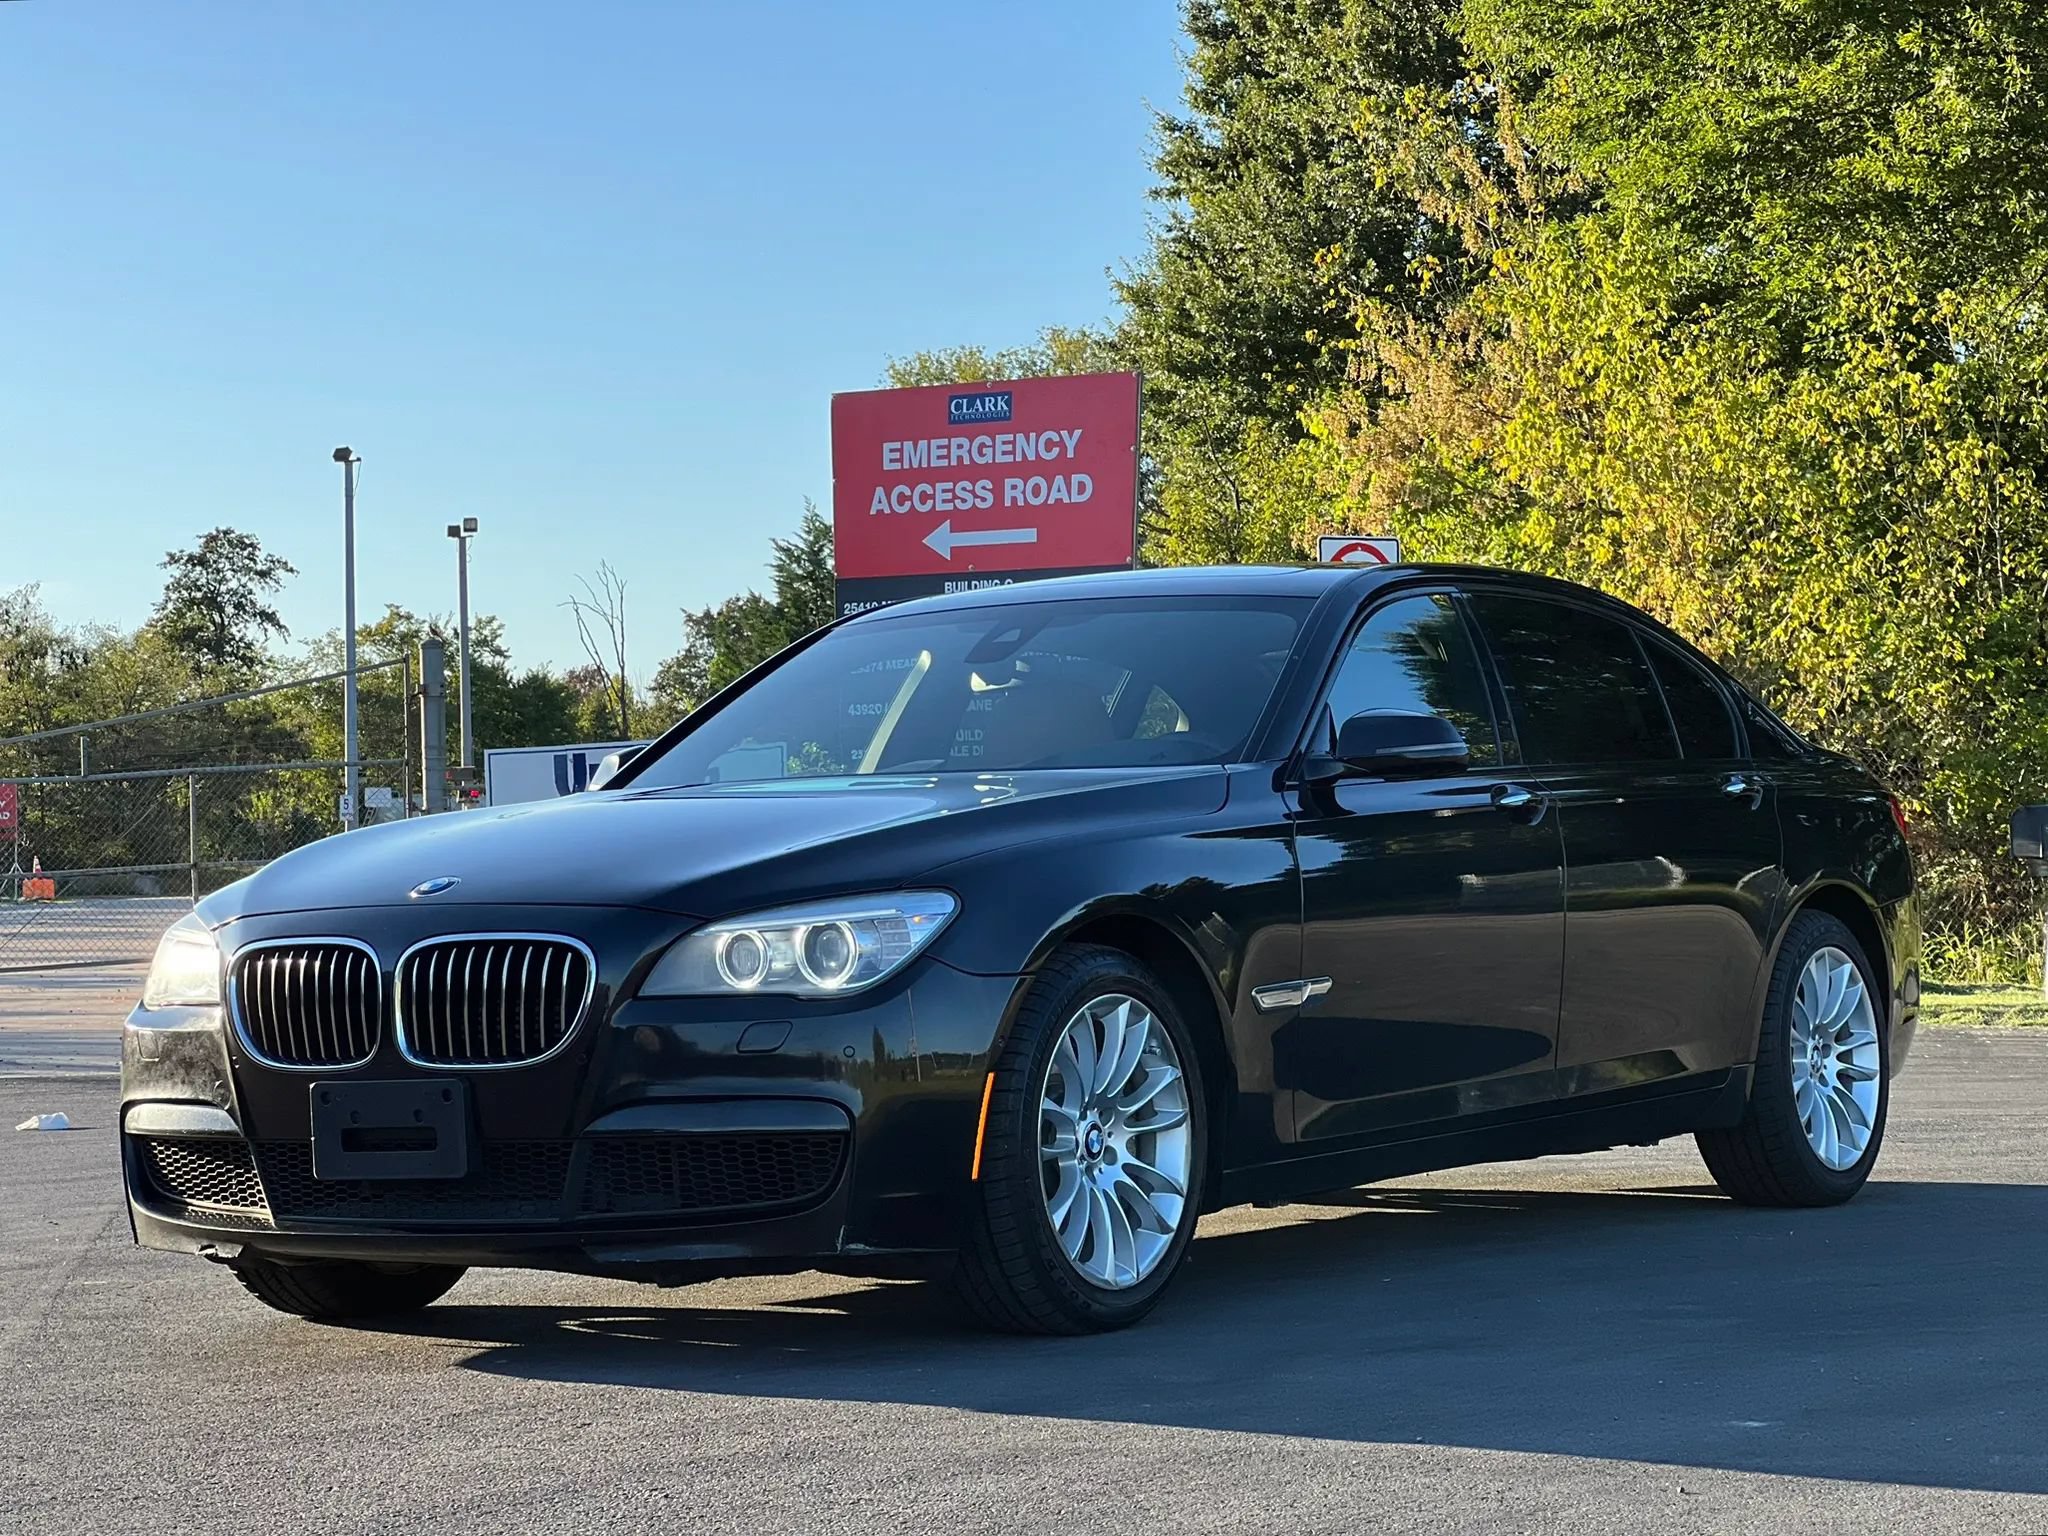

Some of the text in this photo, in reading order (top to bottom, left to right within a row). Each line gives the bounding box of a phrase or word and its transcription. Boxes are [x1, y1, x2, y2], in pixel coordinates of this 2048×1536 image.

[950, 395, 1009, 414] CLARK
[950, 411, 1010, 421] TECHNOLOGIES
[882, 429, 1083, 471] EMERGENCY
[869, 473, 1093, 515] ACCESS ROAD
[848, 703, 881, 716] 43920
[343, 798, 350, 810] 5
